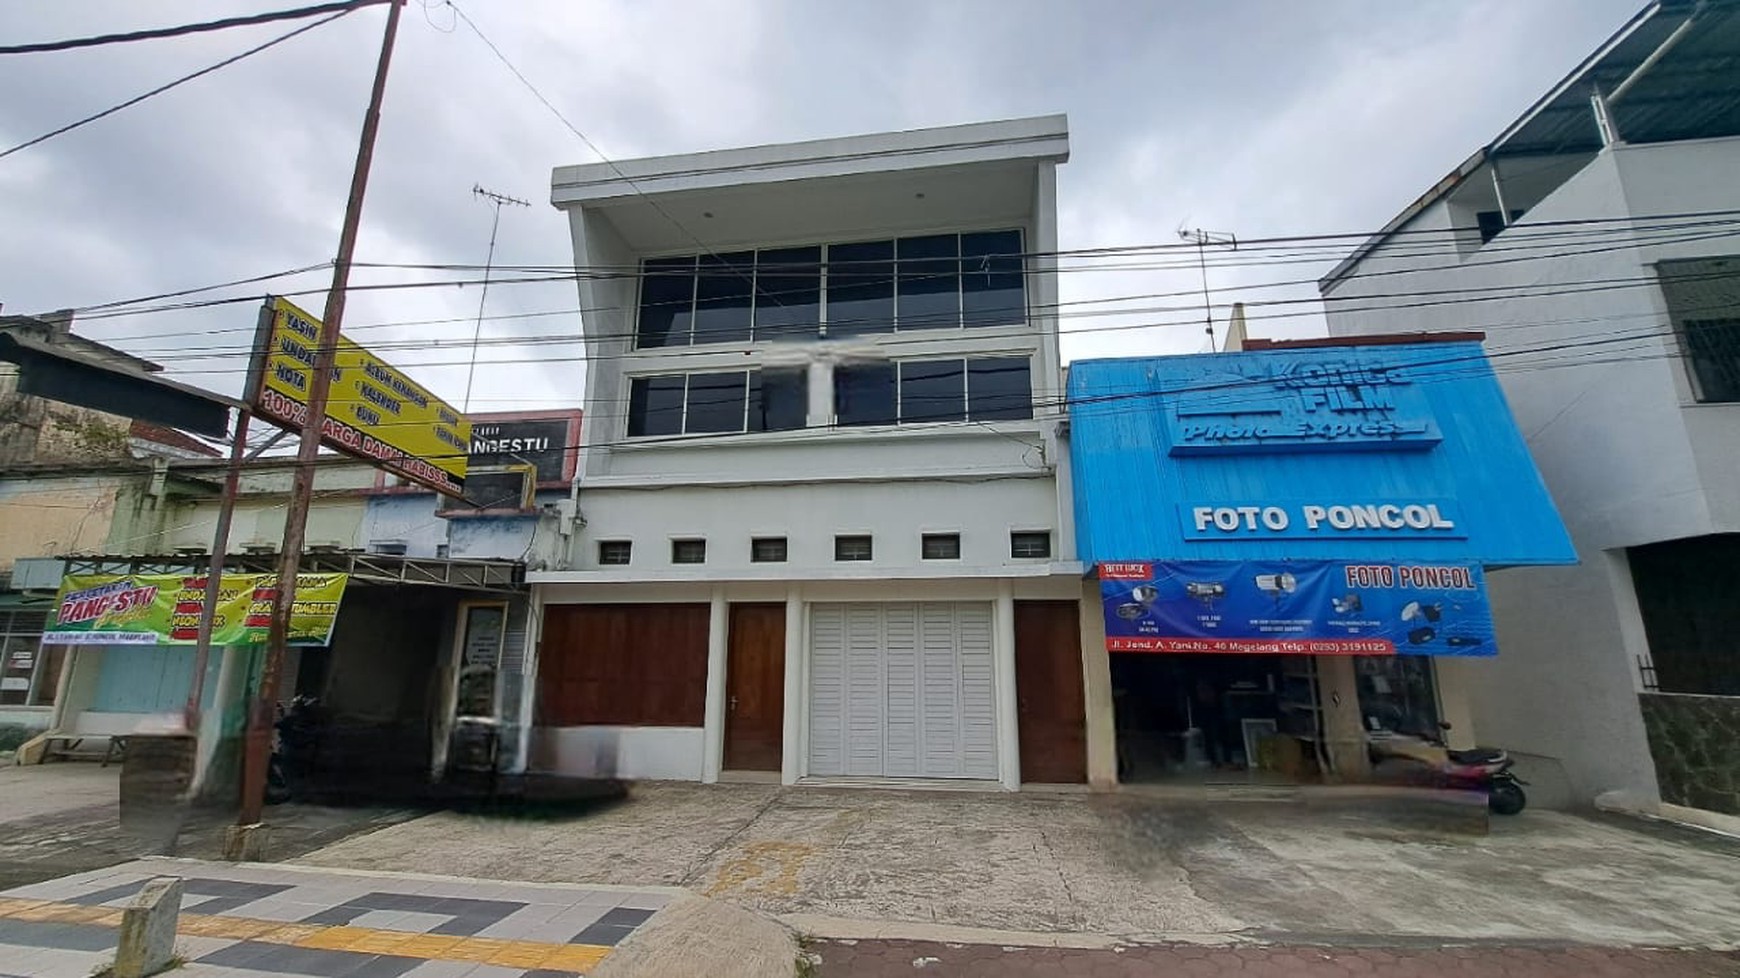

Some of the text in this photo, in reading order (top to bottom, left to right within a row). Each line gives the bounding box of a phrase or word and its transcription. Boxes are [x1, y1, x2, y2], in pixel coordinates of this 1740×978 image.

[286, 310, 318, 340] YASIN
[281, 336, 342, 382] UNDAAN
[275, 365, 306, 391] NOTA
[1274, 361, 1411, 388] Konica
[361, 381, 401, 415] KALENDER
[1299, 385, 1395, 413] FILM
[264, 390, 308, 426] 100%
[322, 418, 362, 450] ARGA
[355, 404, 380, 426] BUKU
[1183, 420, 1275, 441] Photo
[1193, 503, 1455, 531] FOTO PONCOL
[1346, 566, 1476, 591] FOTO PONCOL
[292, 602, 337, 615] TUMBLER
[1155, 641, 1167, 649] A.
[1281, 642, 1306, 653] Telp.
